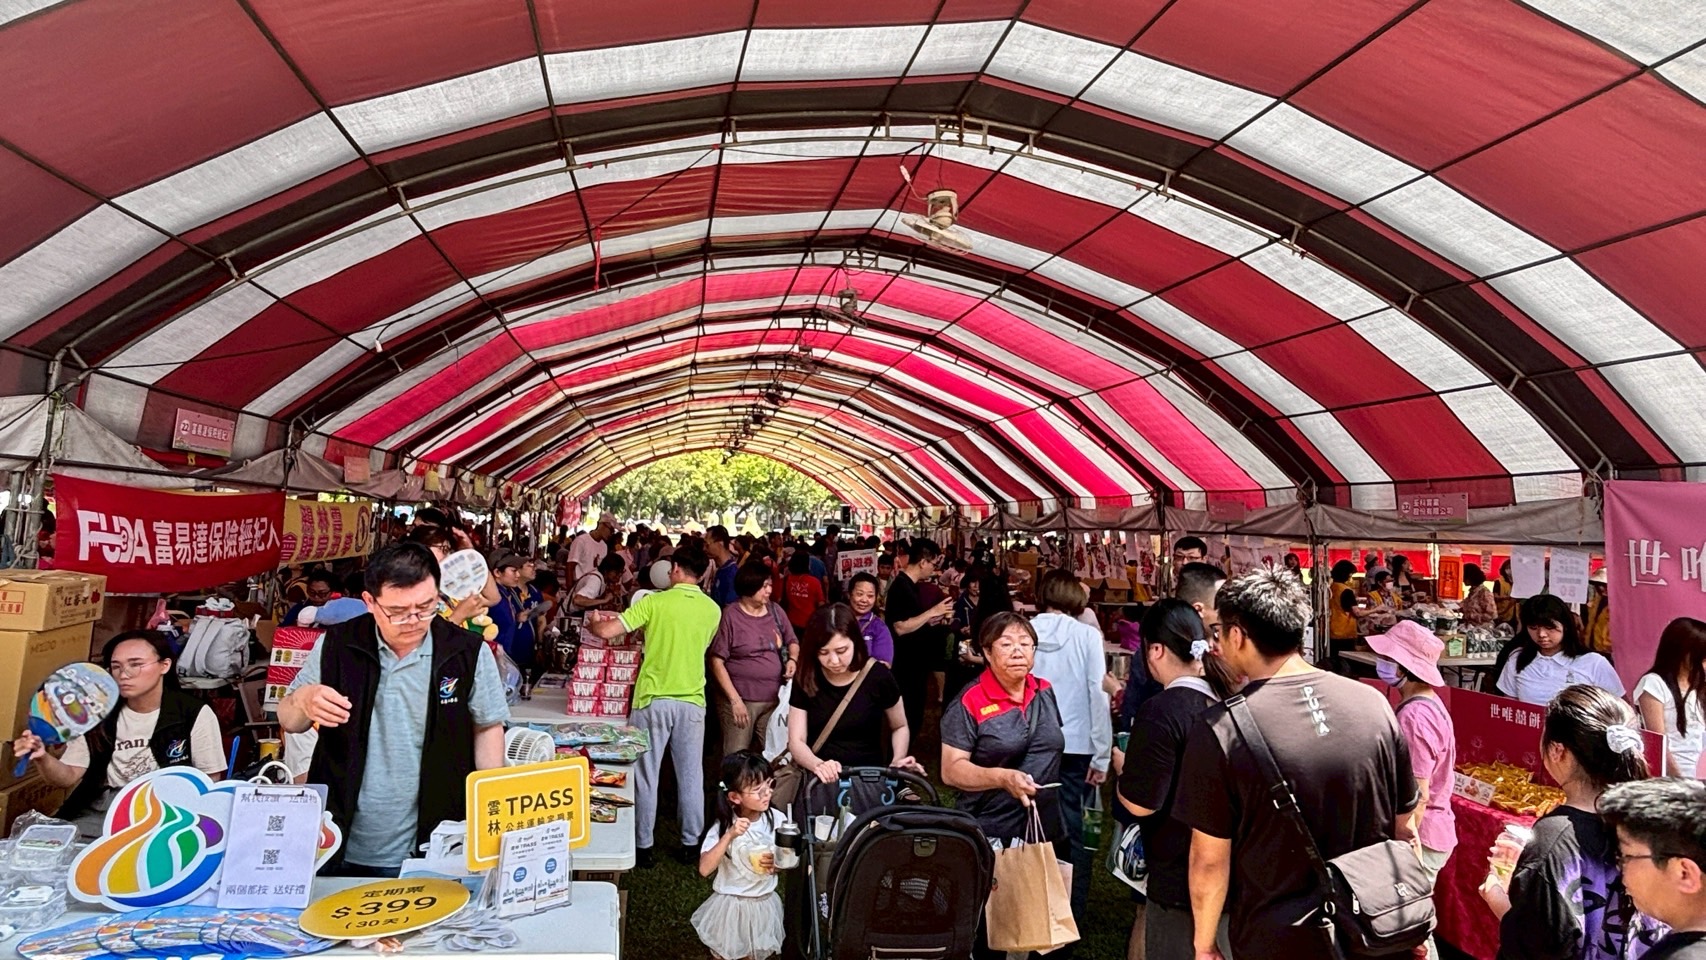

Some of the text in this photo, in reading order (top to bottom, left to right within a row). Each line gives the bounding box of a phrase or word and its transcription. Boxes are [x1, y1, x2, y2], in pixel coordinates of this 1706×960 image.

[76, 509, 153, 565] FUDA
[153, 517, 281, 566] 富易達保險經紀人
[1303, 686, 1331, 735] PUMA
[1490, 703, 1541, 729] 世唯囍餅
[505, 788, 574, 816] TPASS
[487, 800, 501, 836] 雲林
[225, 884, 306, 895] 兩個都按 送好禮
[361, 885, 426, 899] 定期票
[331, 896, 437, 919] $399
[345, 916, 409, 929] (30天)
